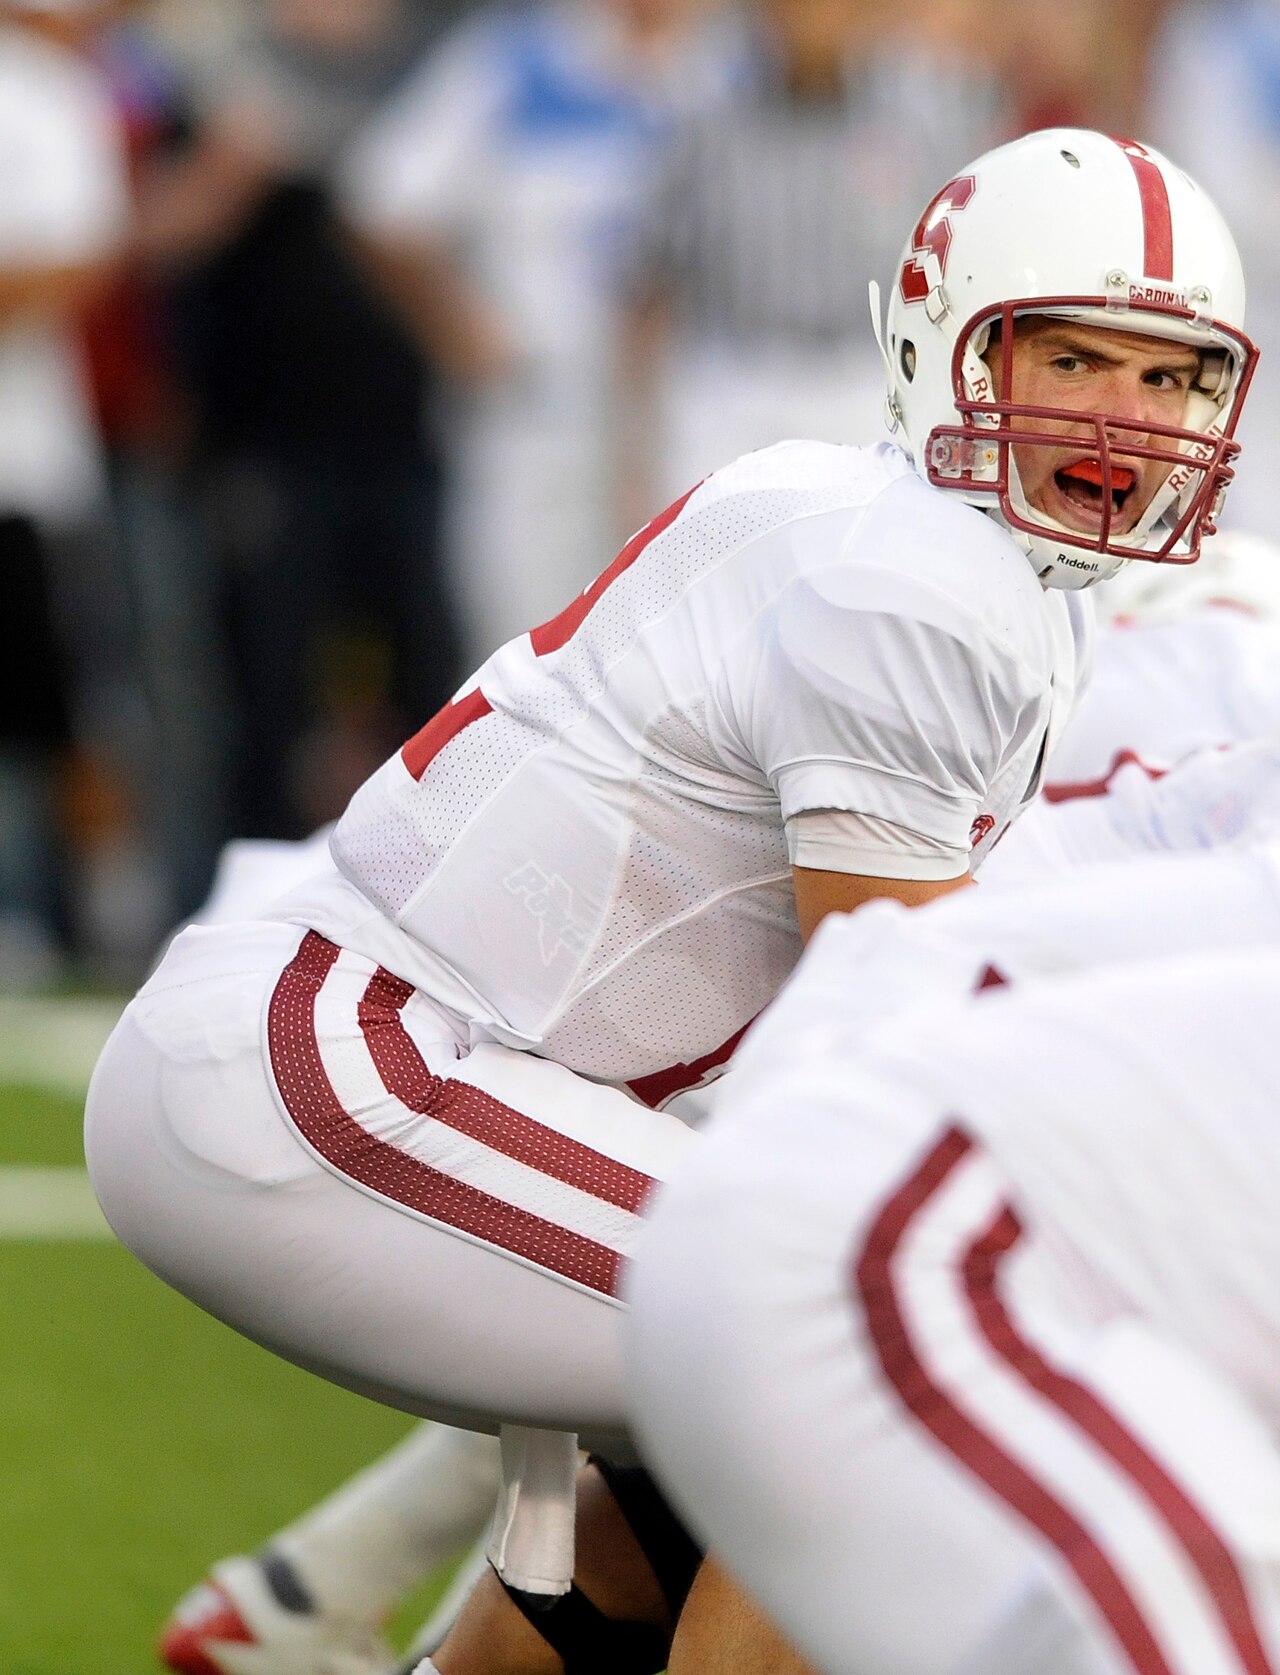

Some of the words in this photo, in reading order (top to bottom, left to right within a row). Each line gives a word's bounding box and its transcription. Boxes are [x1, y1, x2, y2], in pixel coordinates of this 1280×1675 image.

[900, 175, 976, 303] S
[1128, 284, 1188, 308] CARDINAL
[1057, 553, 1100, 572] Riddell
